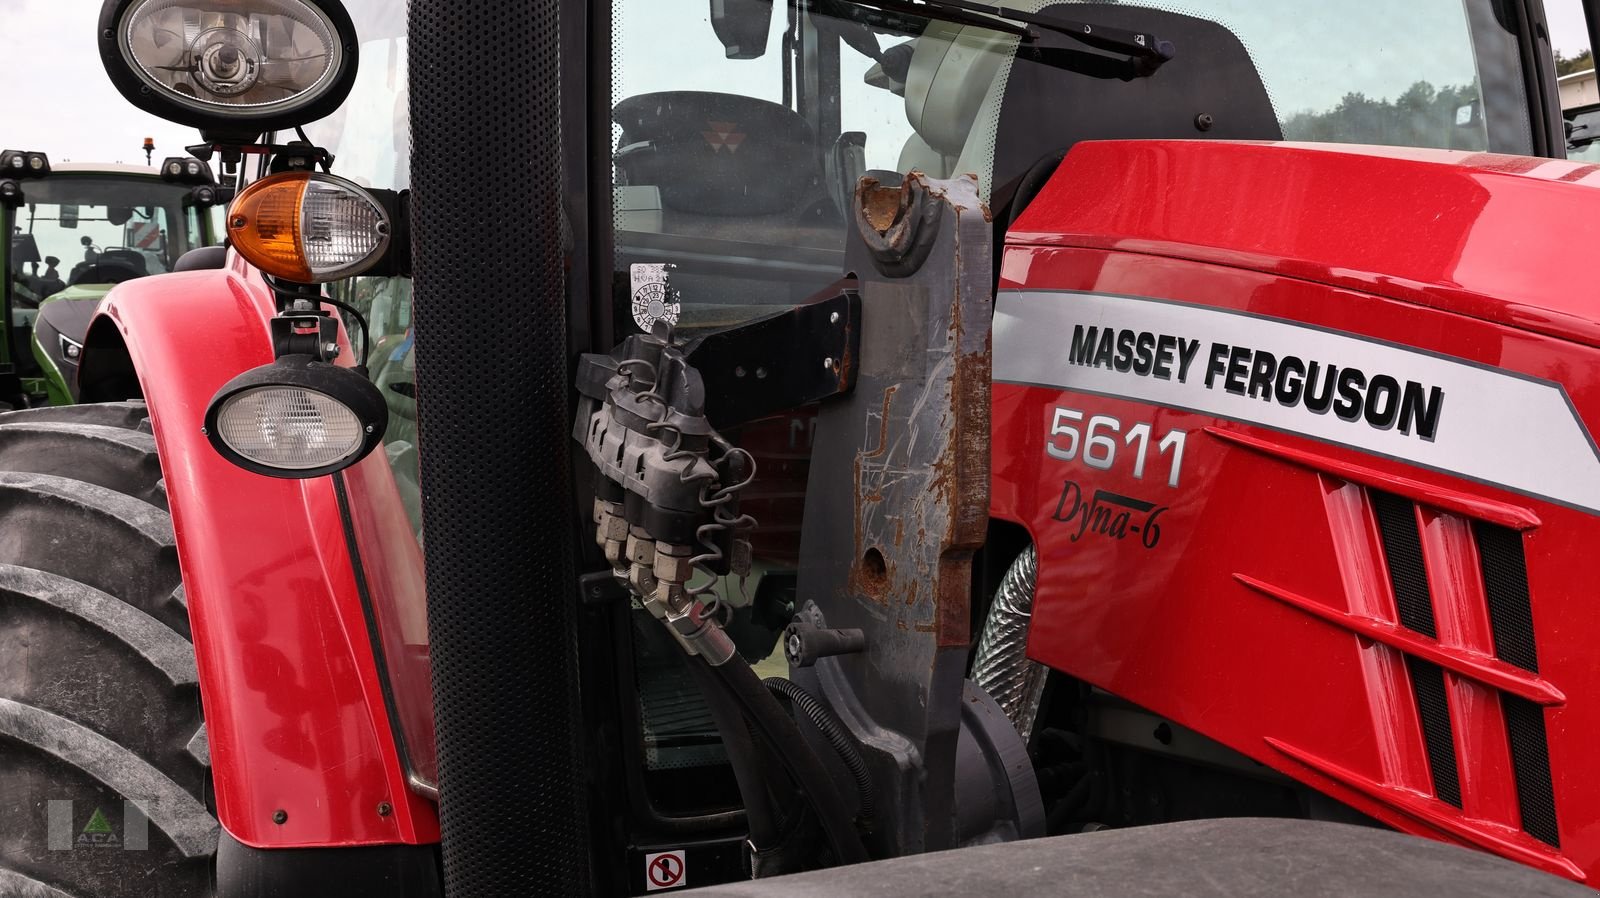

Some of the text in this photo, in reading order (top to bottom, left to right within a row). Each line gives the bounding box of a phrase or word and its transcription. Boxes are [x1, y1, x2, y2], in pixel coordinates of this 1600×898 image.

[1068, 324, 1445, 443] MASSEY FERGUSON
[1046, 407, 1188, 489] 5611
[1052, 480, 1169, 549] Dyna-6
